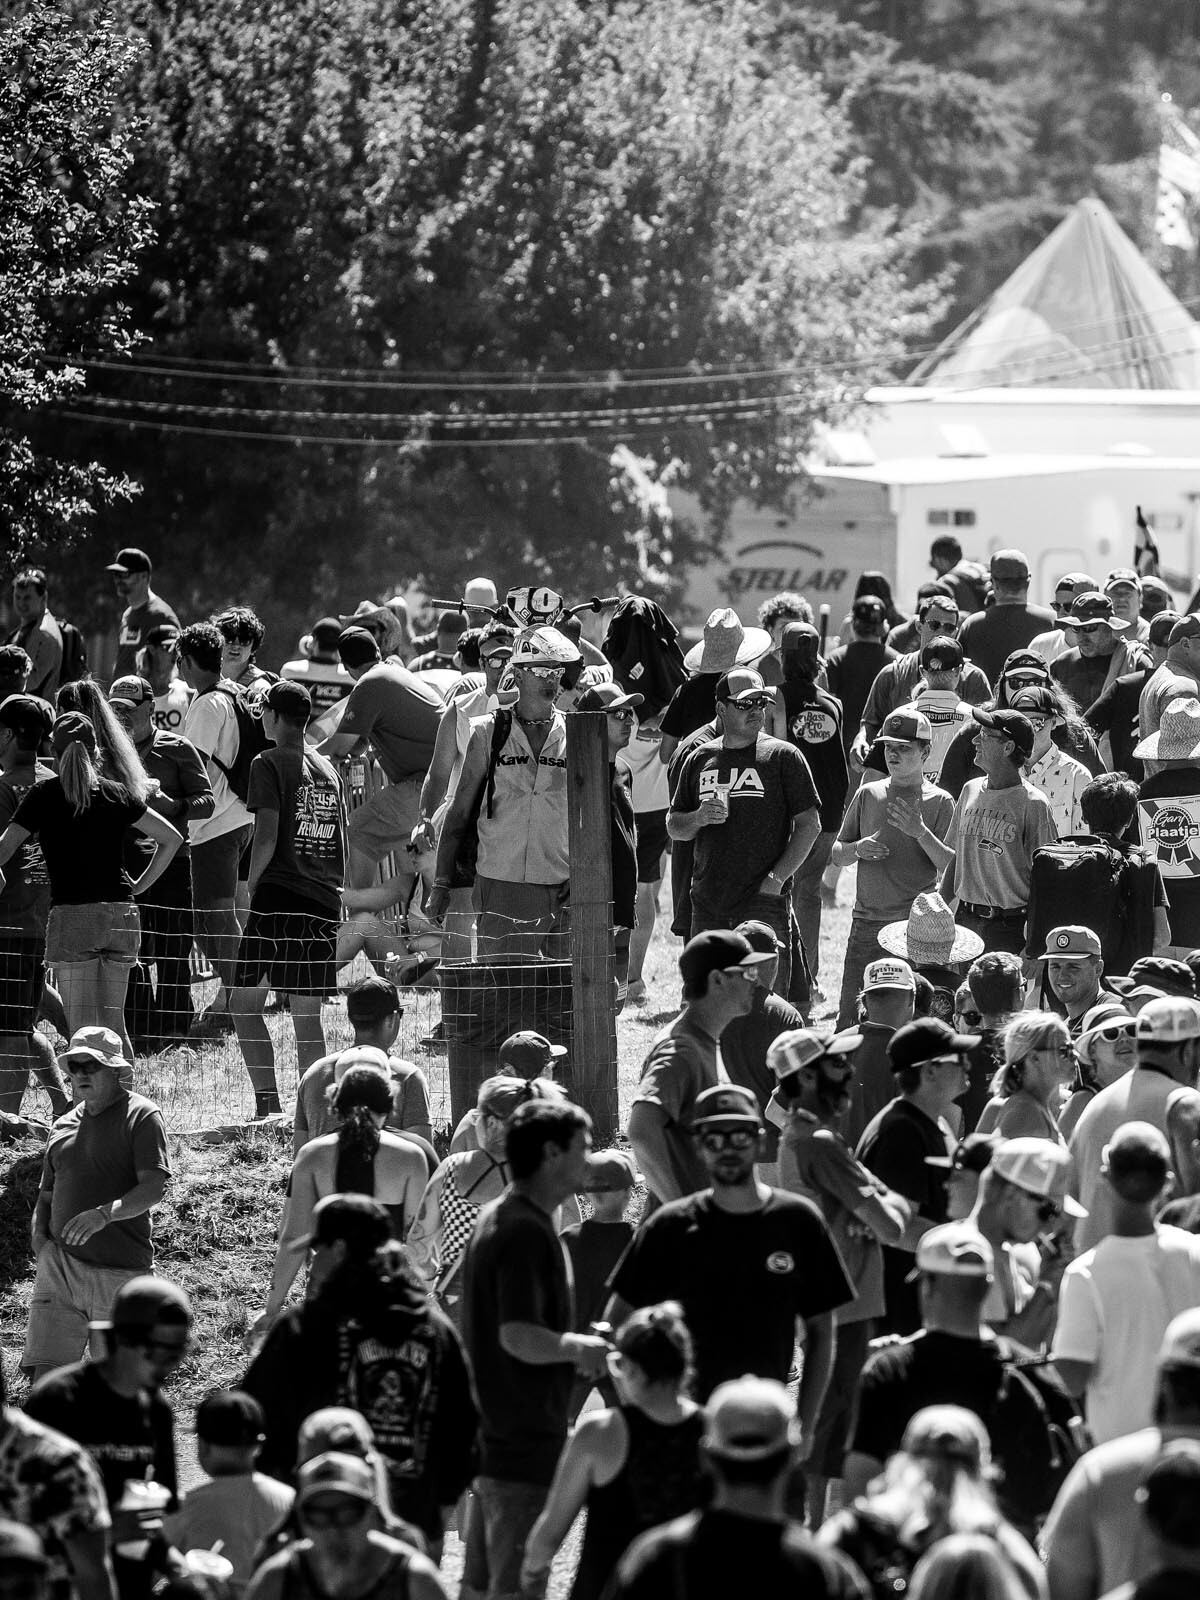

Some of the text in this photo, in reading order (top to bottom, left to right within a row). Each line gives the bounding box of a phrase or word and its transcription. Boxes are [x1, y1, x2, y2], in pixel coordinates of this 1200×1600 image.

[727, 567, 848, 592] STELLAR
[151, 710, 182, 731] RO
[921, 711, 964, 721] ONSTRUCTION
[1155, 810, 1185, 828] Gary
[1147, 826, 1199, 840] Plaatje
